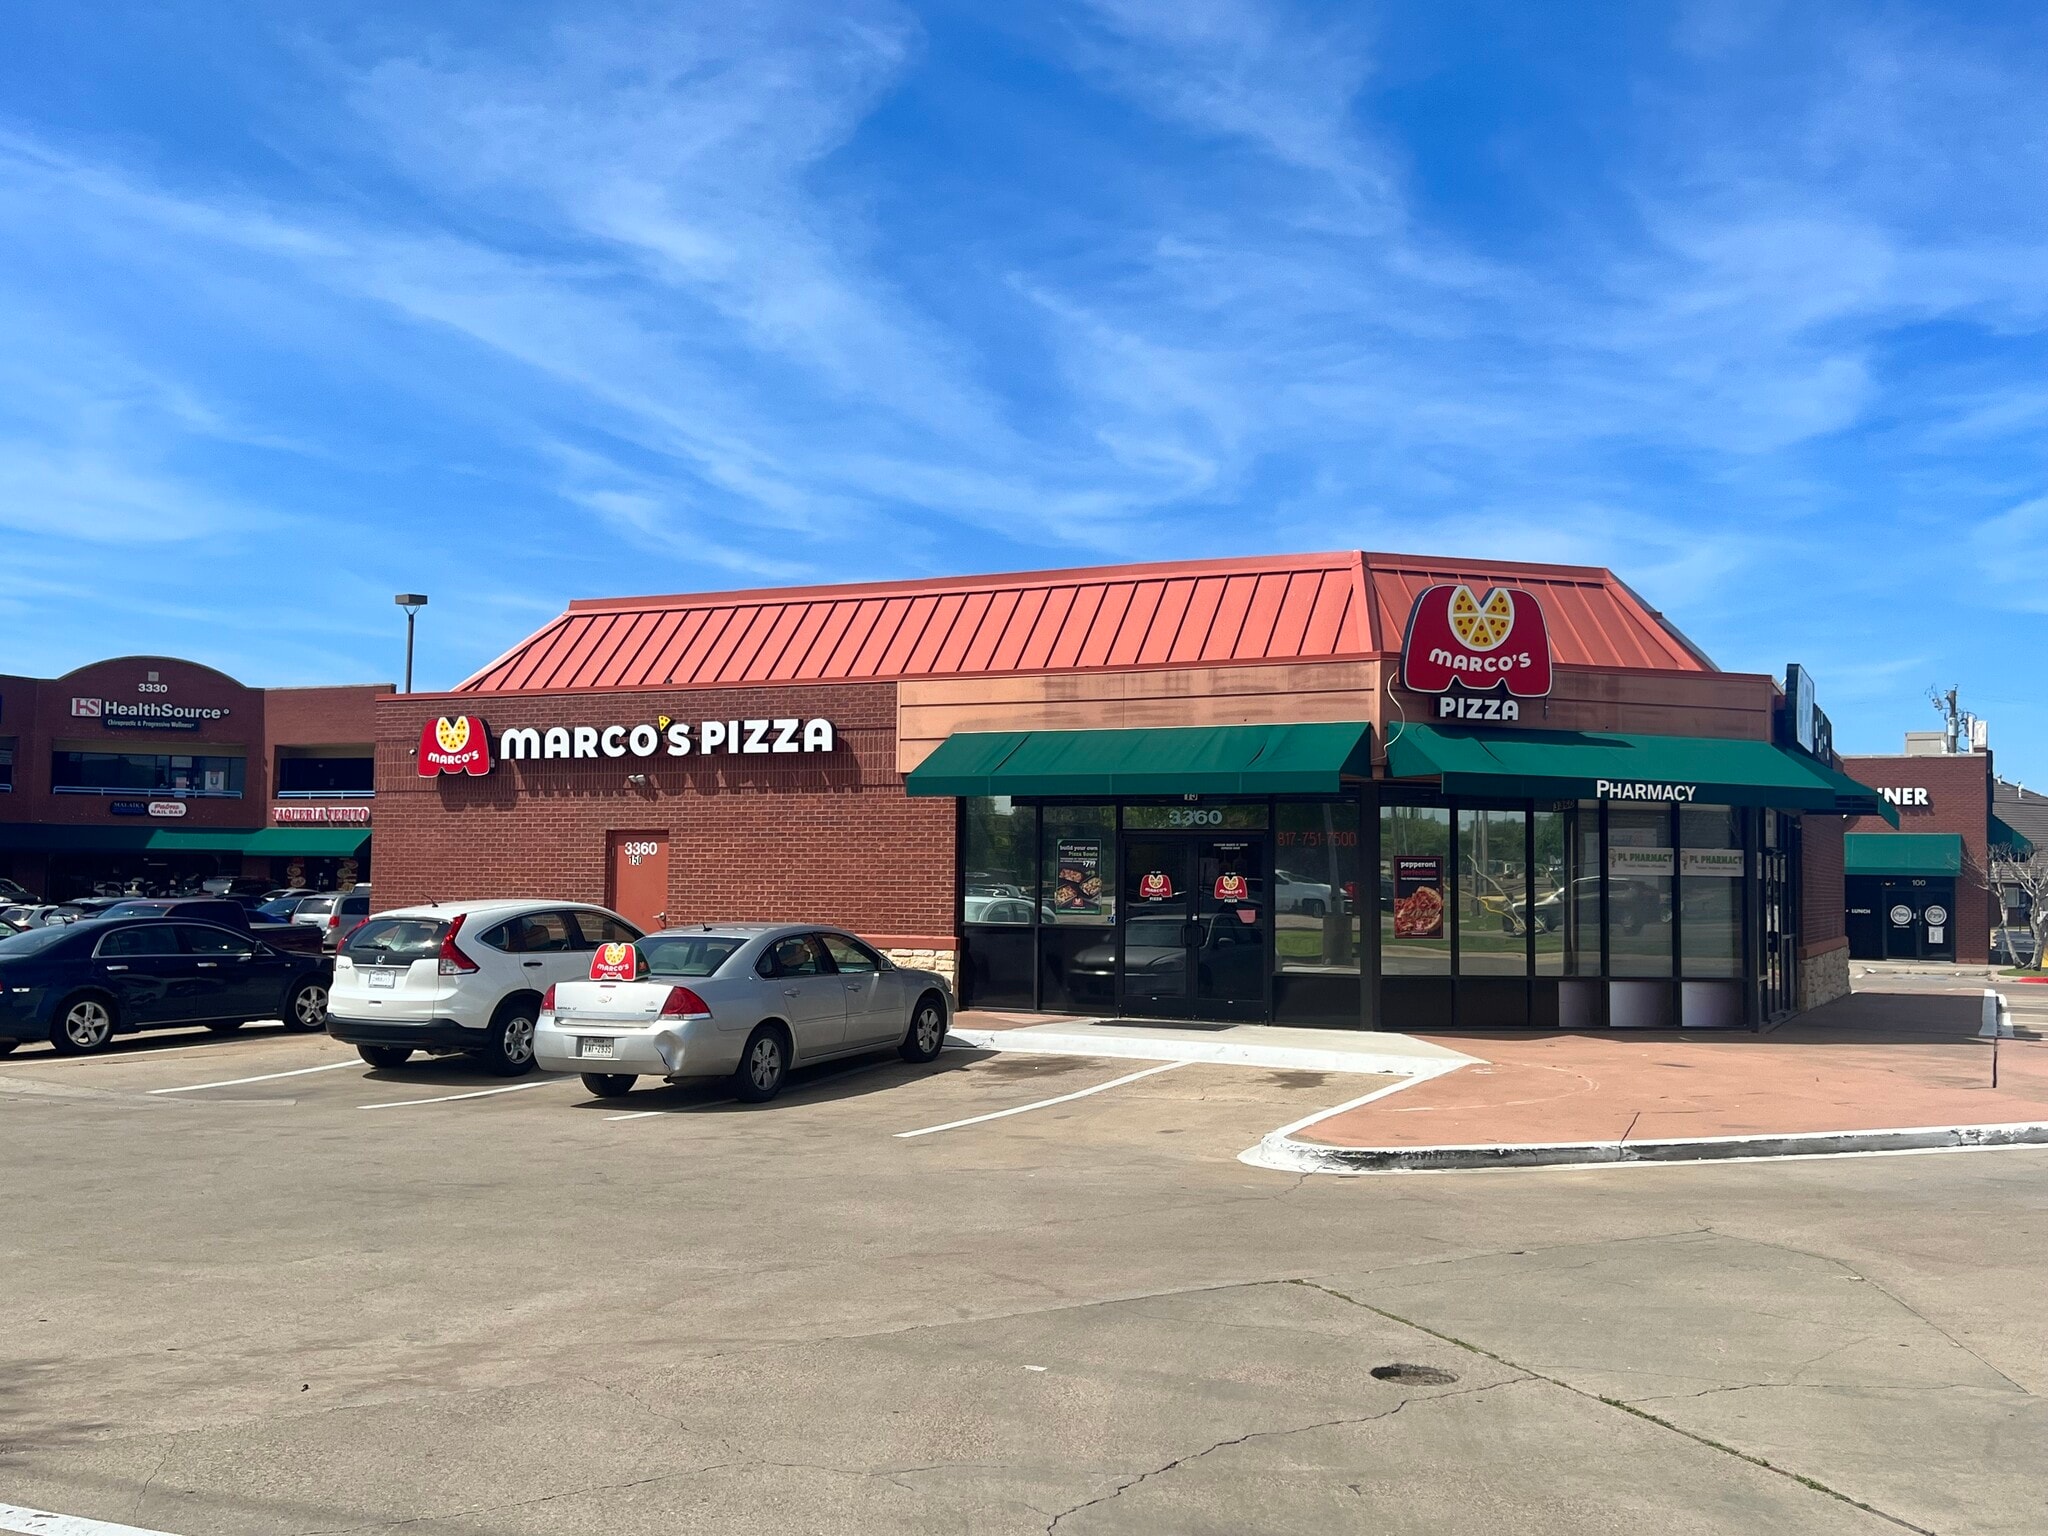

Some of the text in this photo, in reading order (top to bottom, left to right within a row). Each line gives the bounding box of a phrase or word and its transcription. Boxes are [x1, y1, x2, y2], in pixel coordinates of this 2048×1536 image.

[1428, 648, 1532, 673] MARCO'S
[138, 683, 168, 693] 3330
[105, 701, 221, 719] HealthSource
[1439, 697, 1519, 720] PIZZA
[500, 716, 833, 760] MARCO'S PIZZA
[427, 750, 479, 764] MARCO'S
[1596, 780, 1697, 802] PHARMACY
[1877, 787, 1929, 805] NER
[273, 808, 369, 821] TAQUERIA TEPITO
[1169, 810, 1223, 825] 3360
[1277, 831, 1358, 847] 817-751-7500
[624, 842, 658, 856] 3360
[1400, 861, 1436, 869] pepperoni
[1629, 853, 1673, 863] PHARMACY
[1912, 879, 1926, 887] 100
[597, 963, 630, 972] MARCO'S
